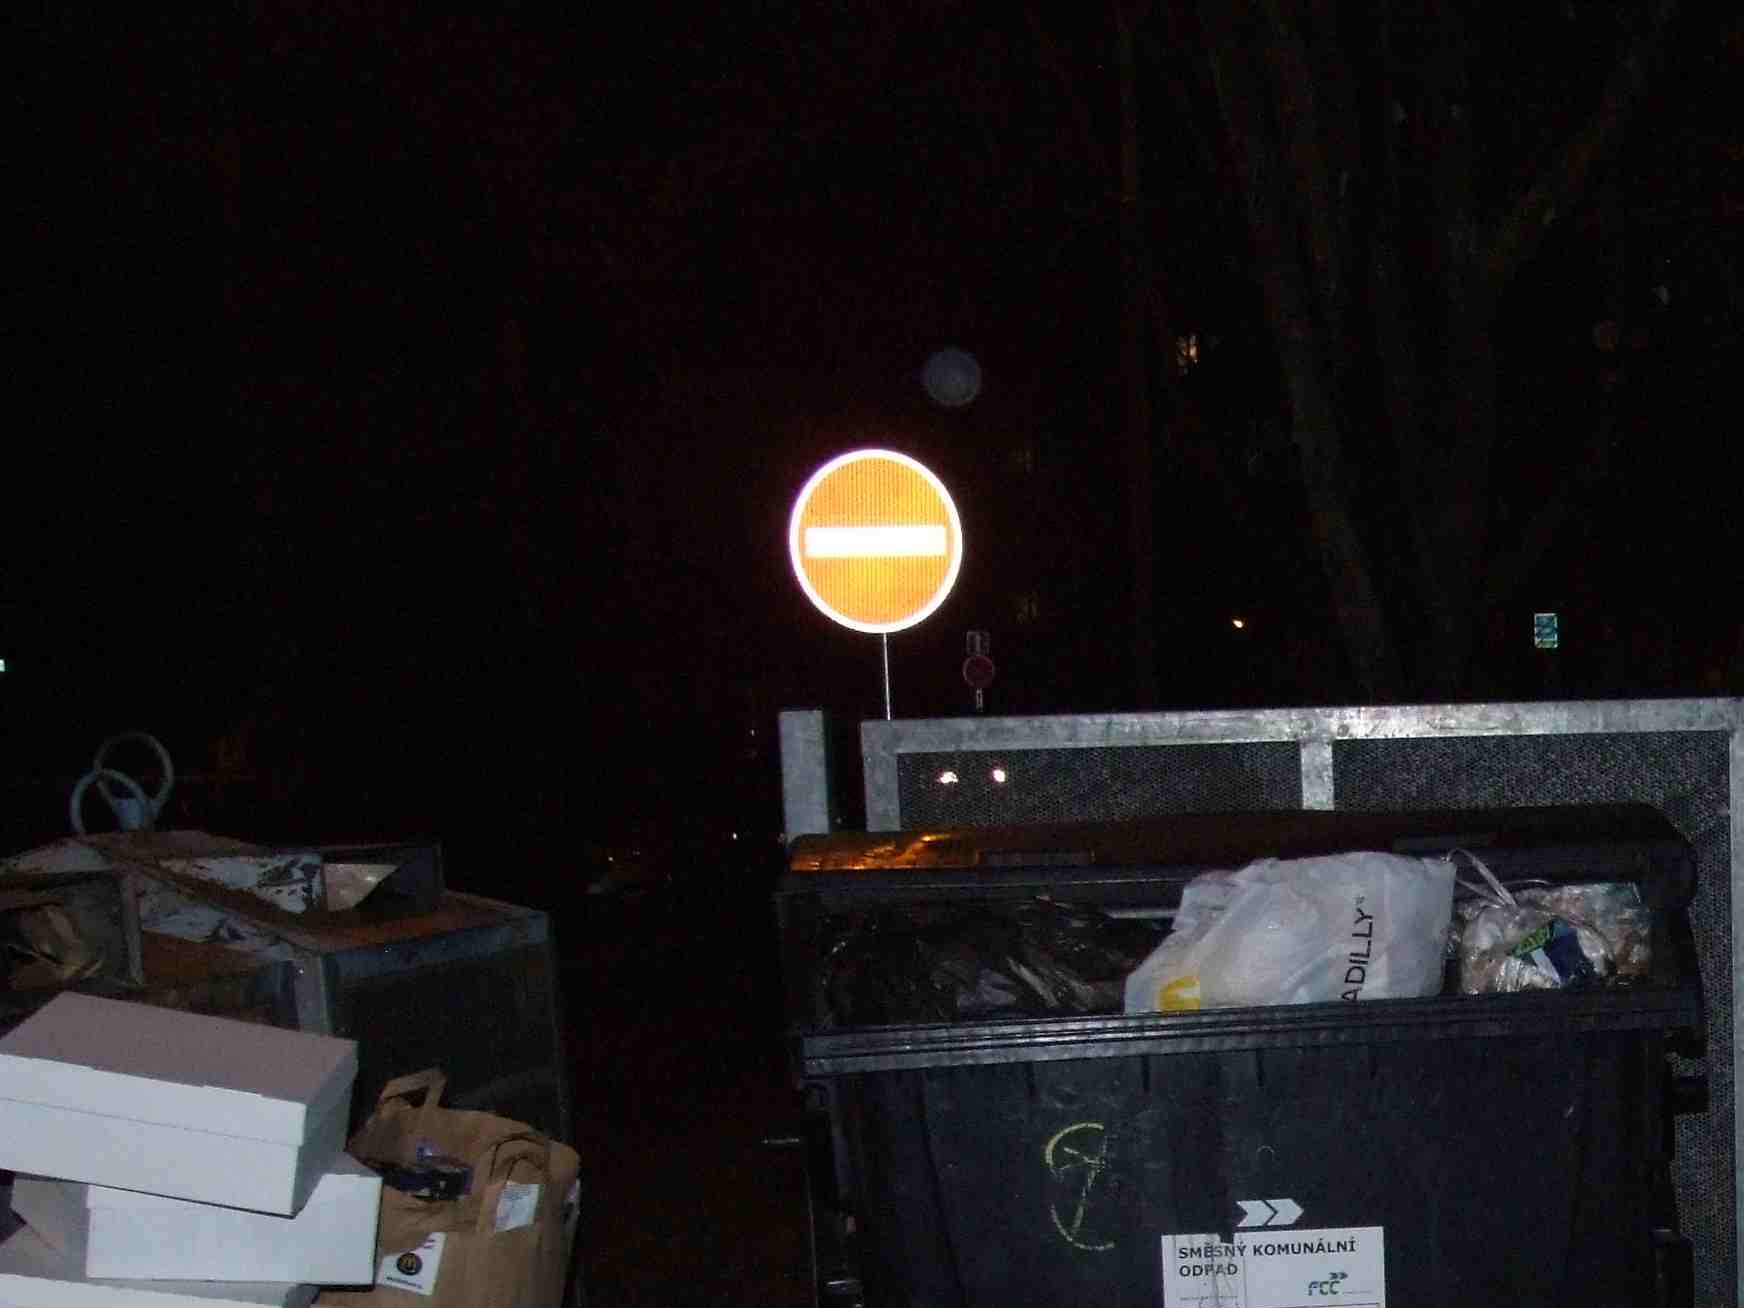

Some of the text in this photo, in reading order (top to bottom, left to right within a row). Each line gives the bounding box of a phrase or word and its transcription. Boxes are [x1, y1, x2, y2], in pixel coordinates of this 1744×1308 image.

[1252, 1239, 1357, 1257] KOMUNÁLNÍ
[1178, 1263, 1238, 1277] ODPAD
[1307, 1279, 1341, 1296] FCC
